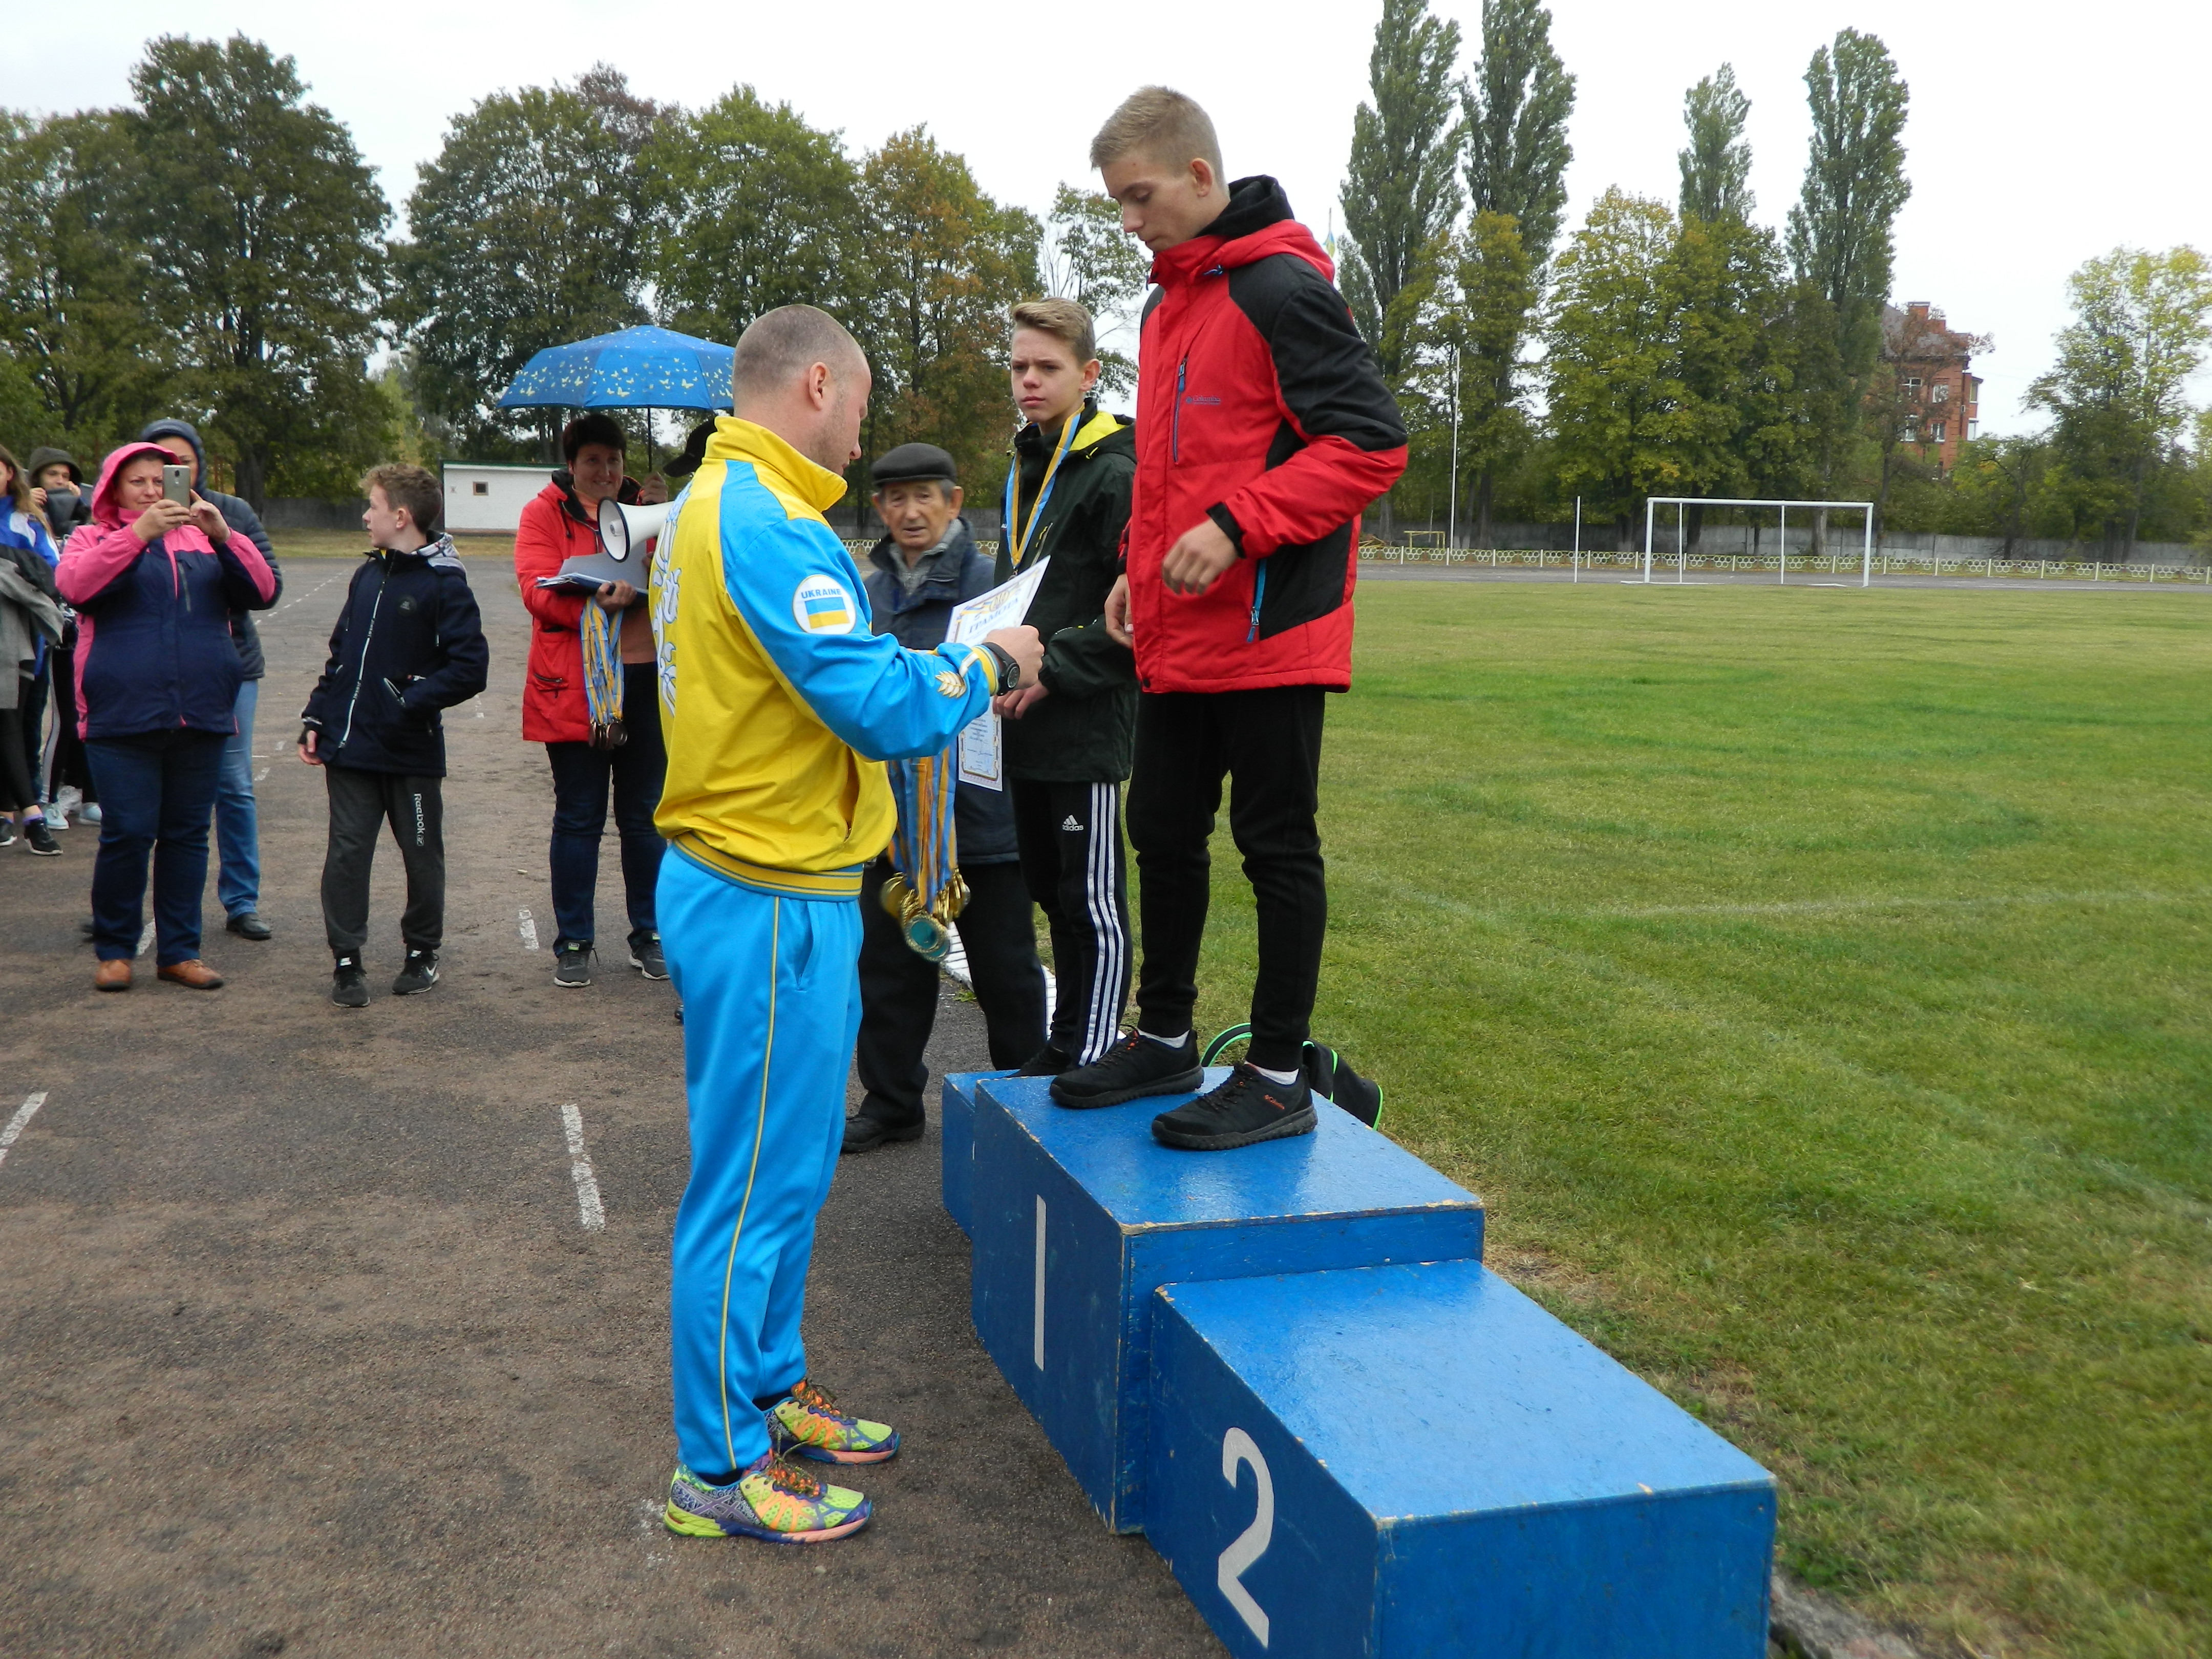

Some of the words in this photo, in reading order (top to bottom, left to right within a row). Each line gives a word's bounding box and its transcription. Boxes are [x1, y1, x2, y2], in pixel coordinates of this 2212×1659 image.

[801, 588, 842, 599] UKRAINE
[969, 598, 1018, 633] ГРАМОТА
[414, 793, 426, 834] Reebok
[1034, 1194, 1047, 1371] 1
[1217, 1427, 1275, 1649] 2
